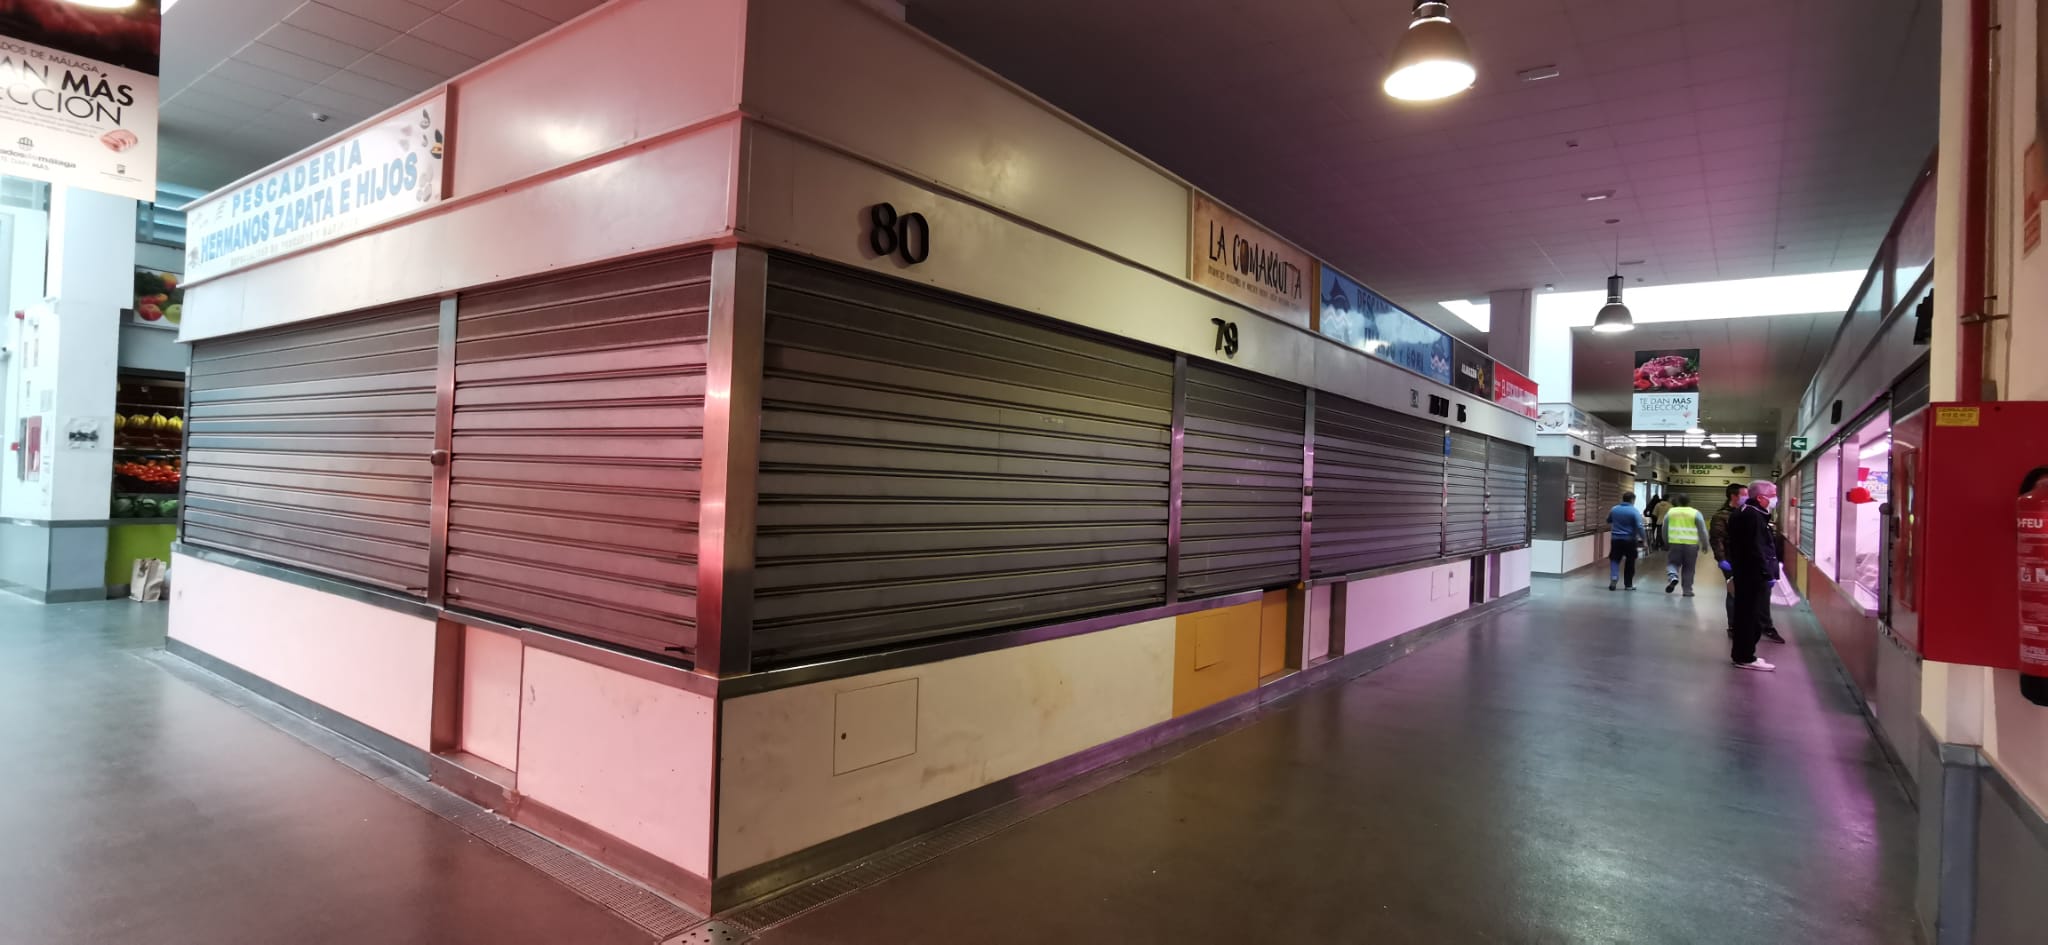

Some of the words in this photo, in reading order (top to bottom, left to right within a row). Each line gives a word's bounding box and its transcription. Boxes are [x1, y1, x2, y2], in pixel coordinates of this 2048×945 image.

[0, 41, 27, 54] DOS
[29, 48, 45, 60] DE
[0, 81, 121, 126] CCIÓN
[61, 71, 134, 107] MÁS
[231, 139, 363, 218] PESCADERIA
[200, 210, 270, 264] HERMANOS
[273, 186, 334, 238] ZAPATA
[339, 180, 351, 214] E
[355, 152, 418, 209] HIJOS
[871, 202, 929, 264] 80
[1209, 219, 1227, 266] LA
[1232, 234, 1302, 300] COMARQUITA
[1211, 318, 1239, 359] 79
